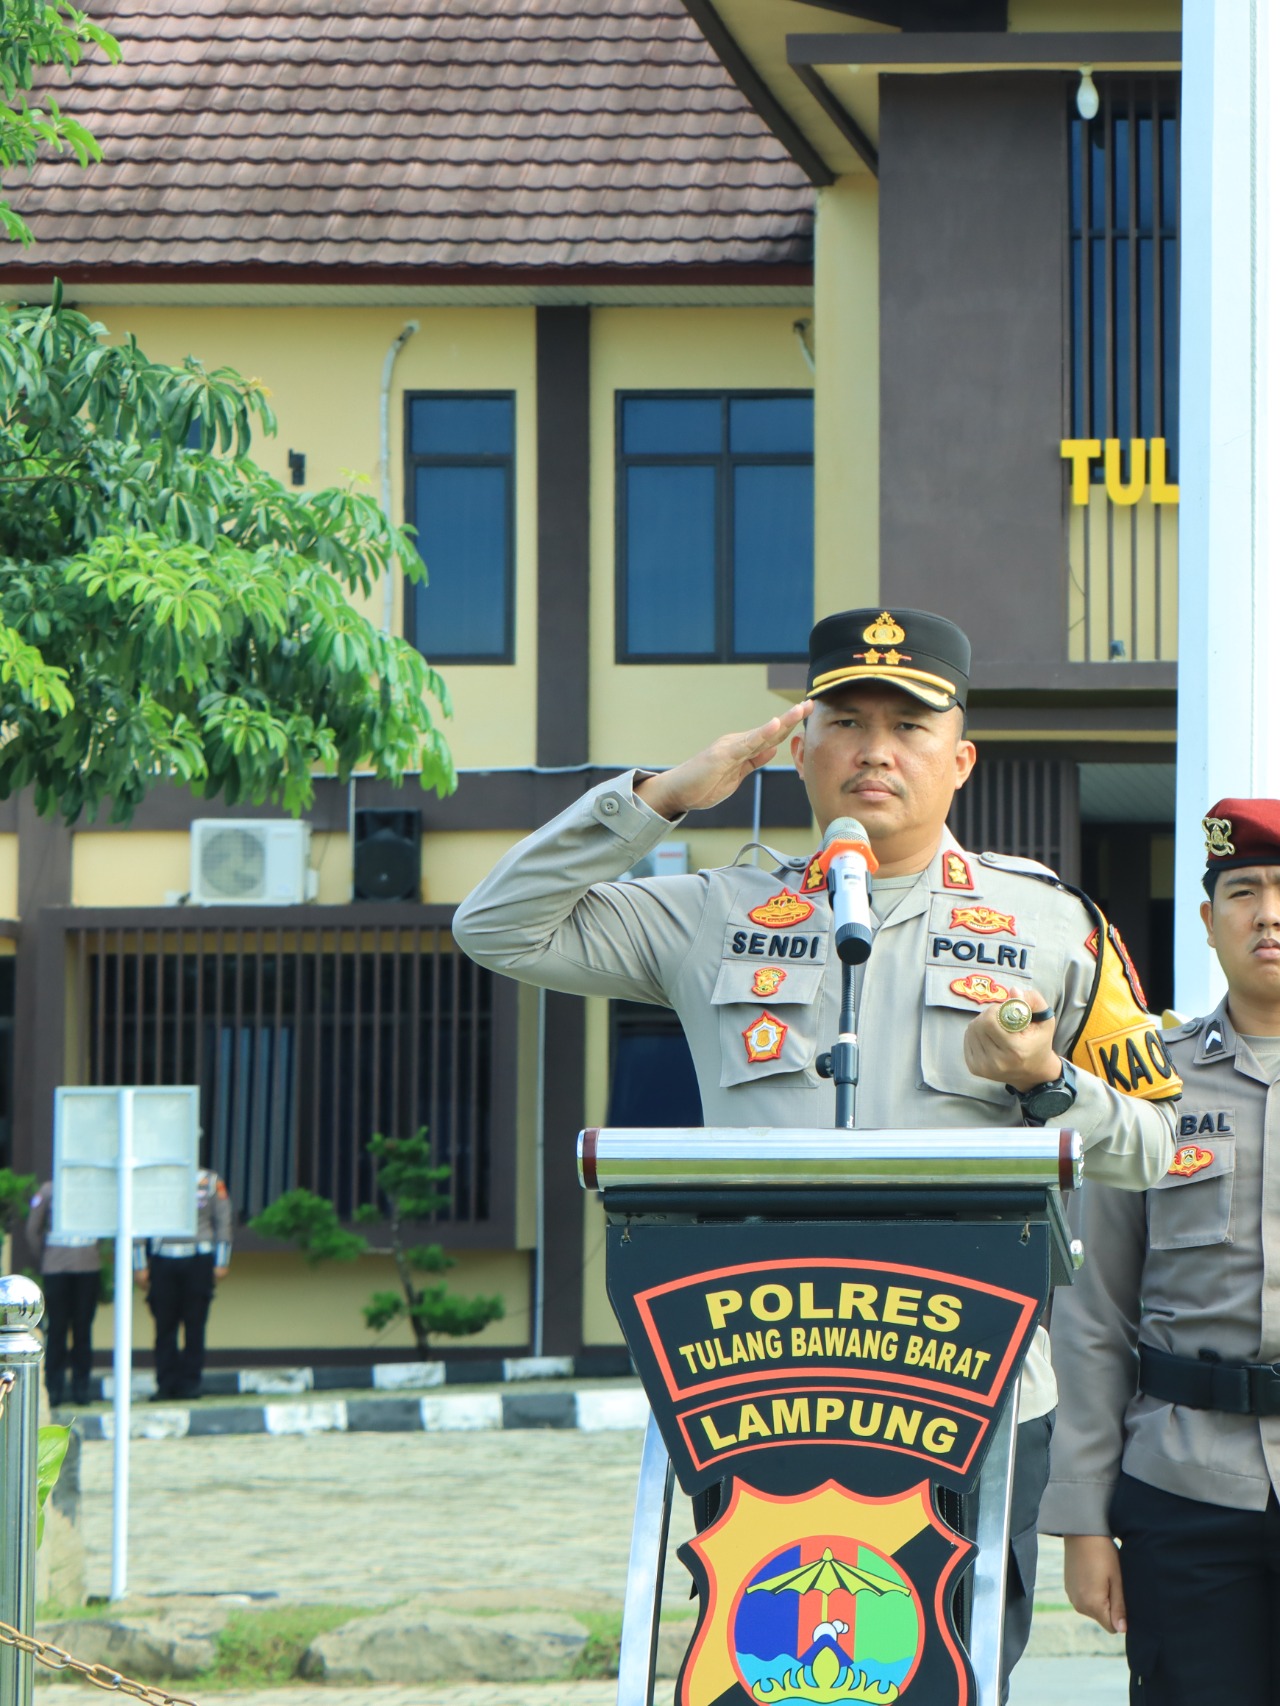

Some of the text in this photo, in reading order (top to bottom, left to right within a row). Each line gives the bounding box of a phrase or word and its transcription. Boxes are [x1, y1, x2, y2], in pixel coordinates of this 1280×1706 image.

[731, 930, 820, 960] SENDI
[932, 936, 1028, 971] POLRI
[1099, 1031, 1178, 1093] KAO
[1176, 1112, 1231, 1137] BAL
[704, 1281, 964, 1333] POLRES
[678, 1326, 992, 1380] TULANG BAWANG BARAT
[700, 1396, 959, 1455] LAMPUNG
